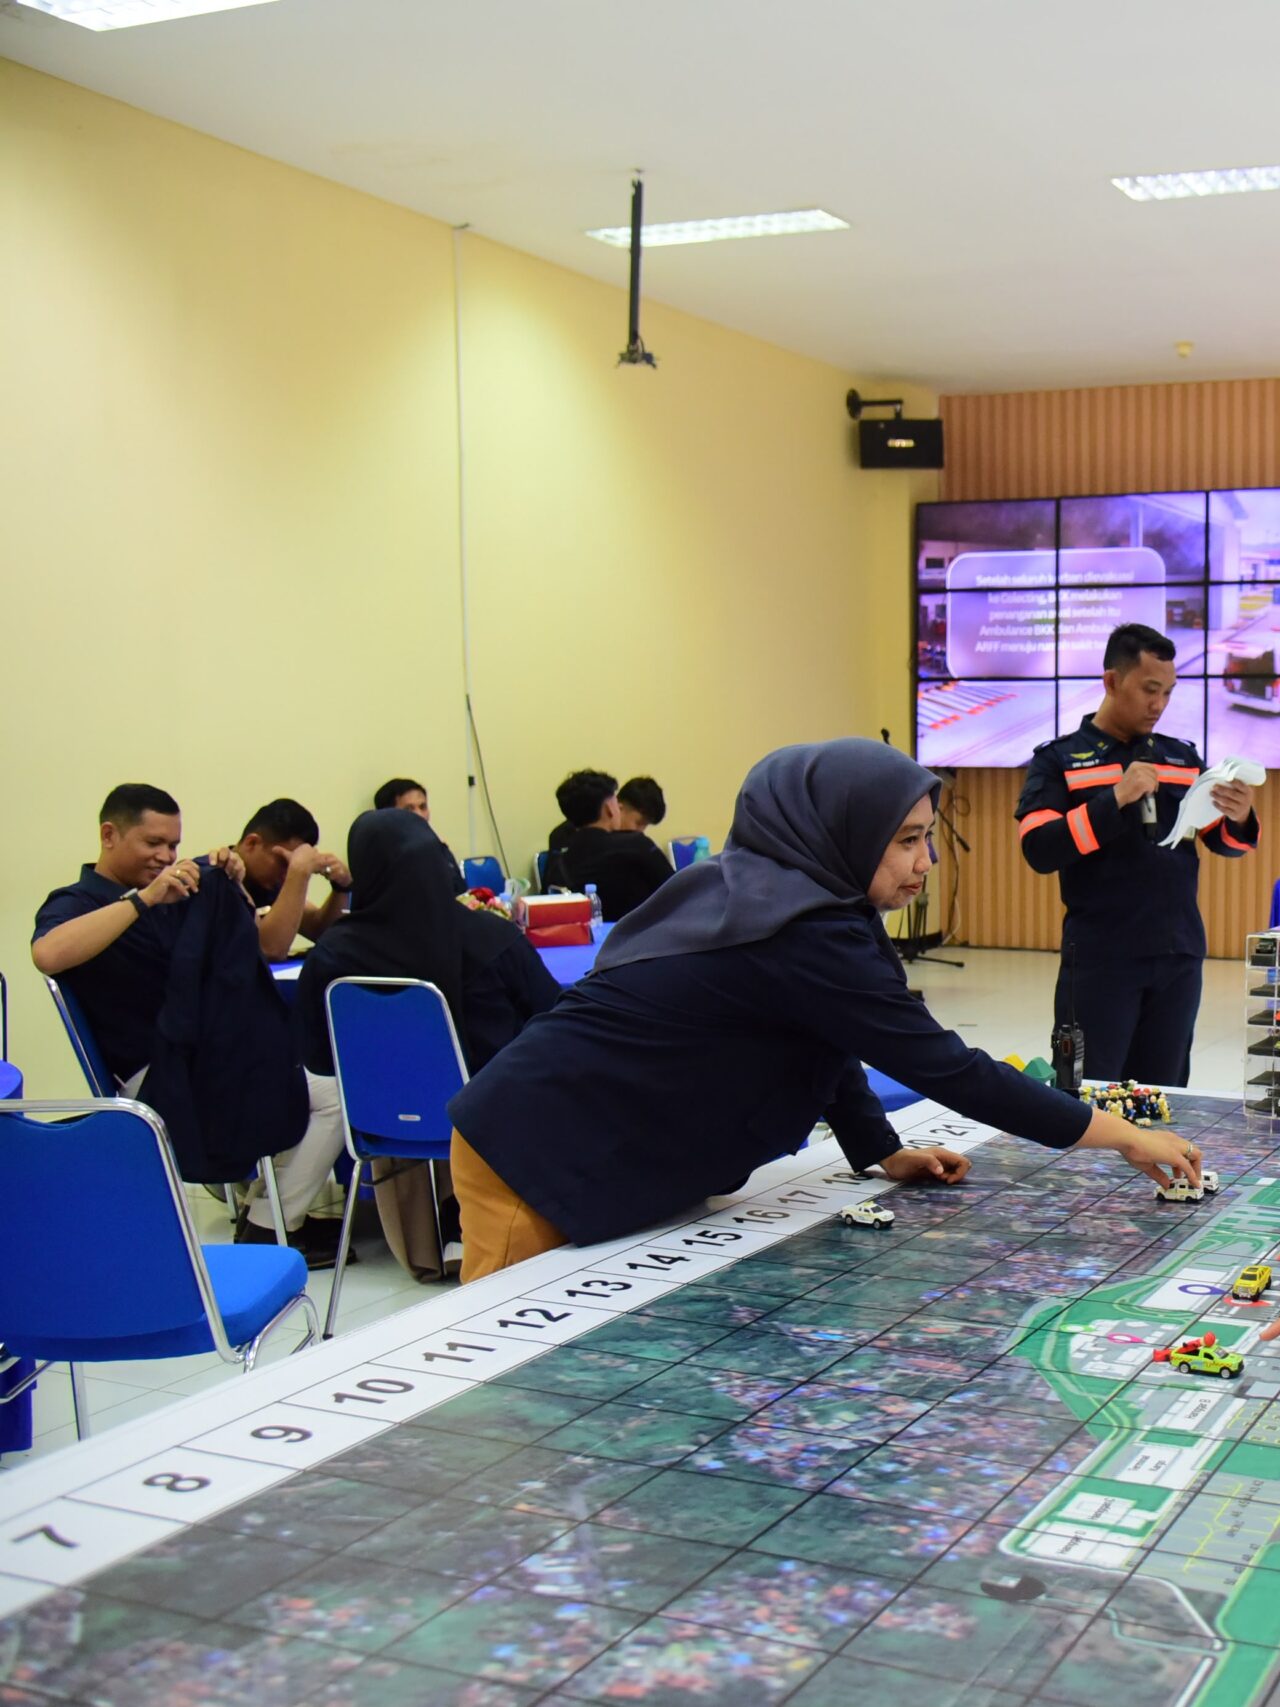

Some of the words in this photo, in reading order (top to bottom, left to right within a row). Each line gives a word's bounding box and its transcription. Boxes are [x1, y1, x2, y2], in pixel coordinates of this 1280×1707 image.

[930, 1124, 978, 1137] 21
[822, 1172, 875, 1186] 18
[776, 1188, 829, 1205] 17
[731, 1205, 791, 1225] 16
[681, 1229, 743, 1248] 15
[625, 1253, 692, 1272] 14
[565, 1279, 633, 1299] 13
[497, 1307, 574, 1329] 12
[422, 1340, 496, 1364] 11
[333, 1378, 416, 1407] 10
[250, 1424, 313, 1445] 9
[142, 1471, 211, 1494] 8
[12, 1525, 80, 1552] 7
